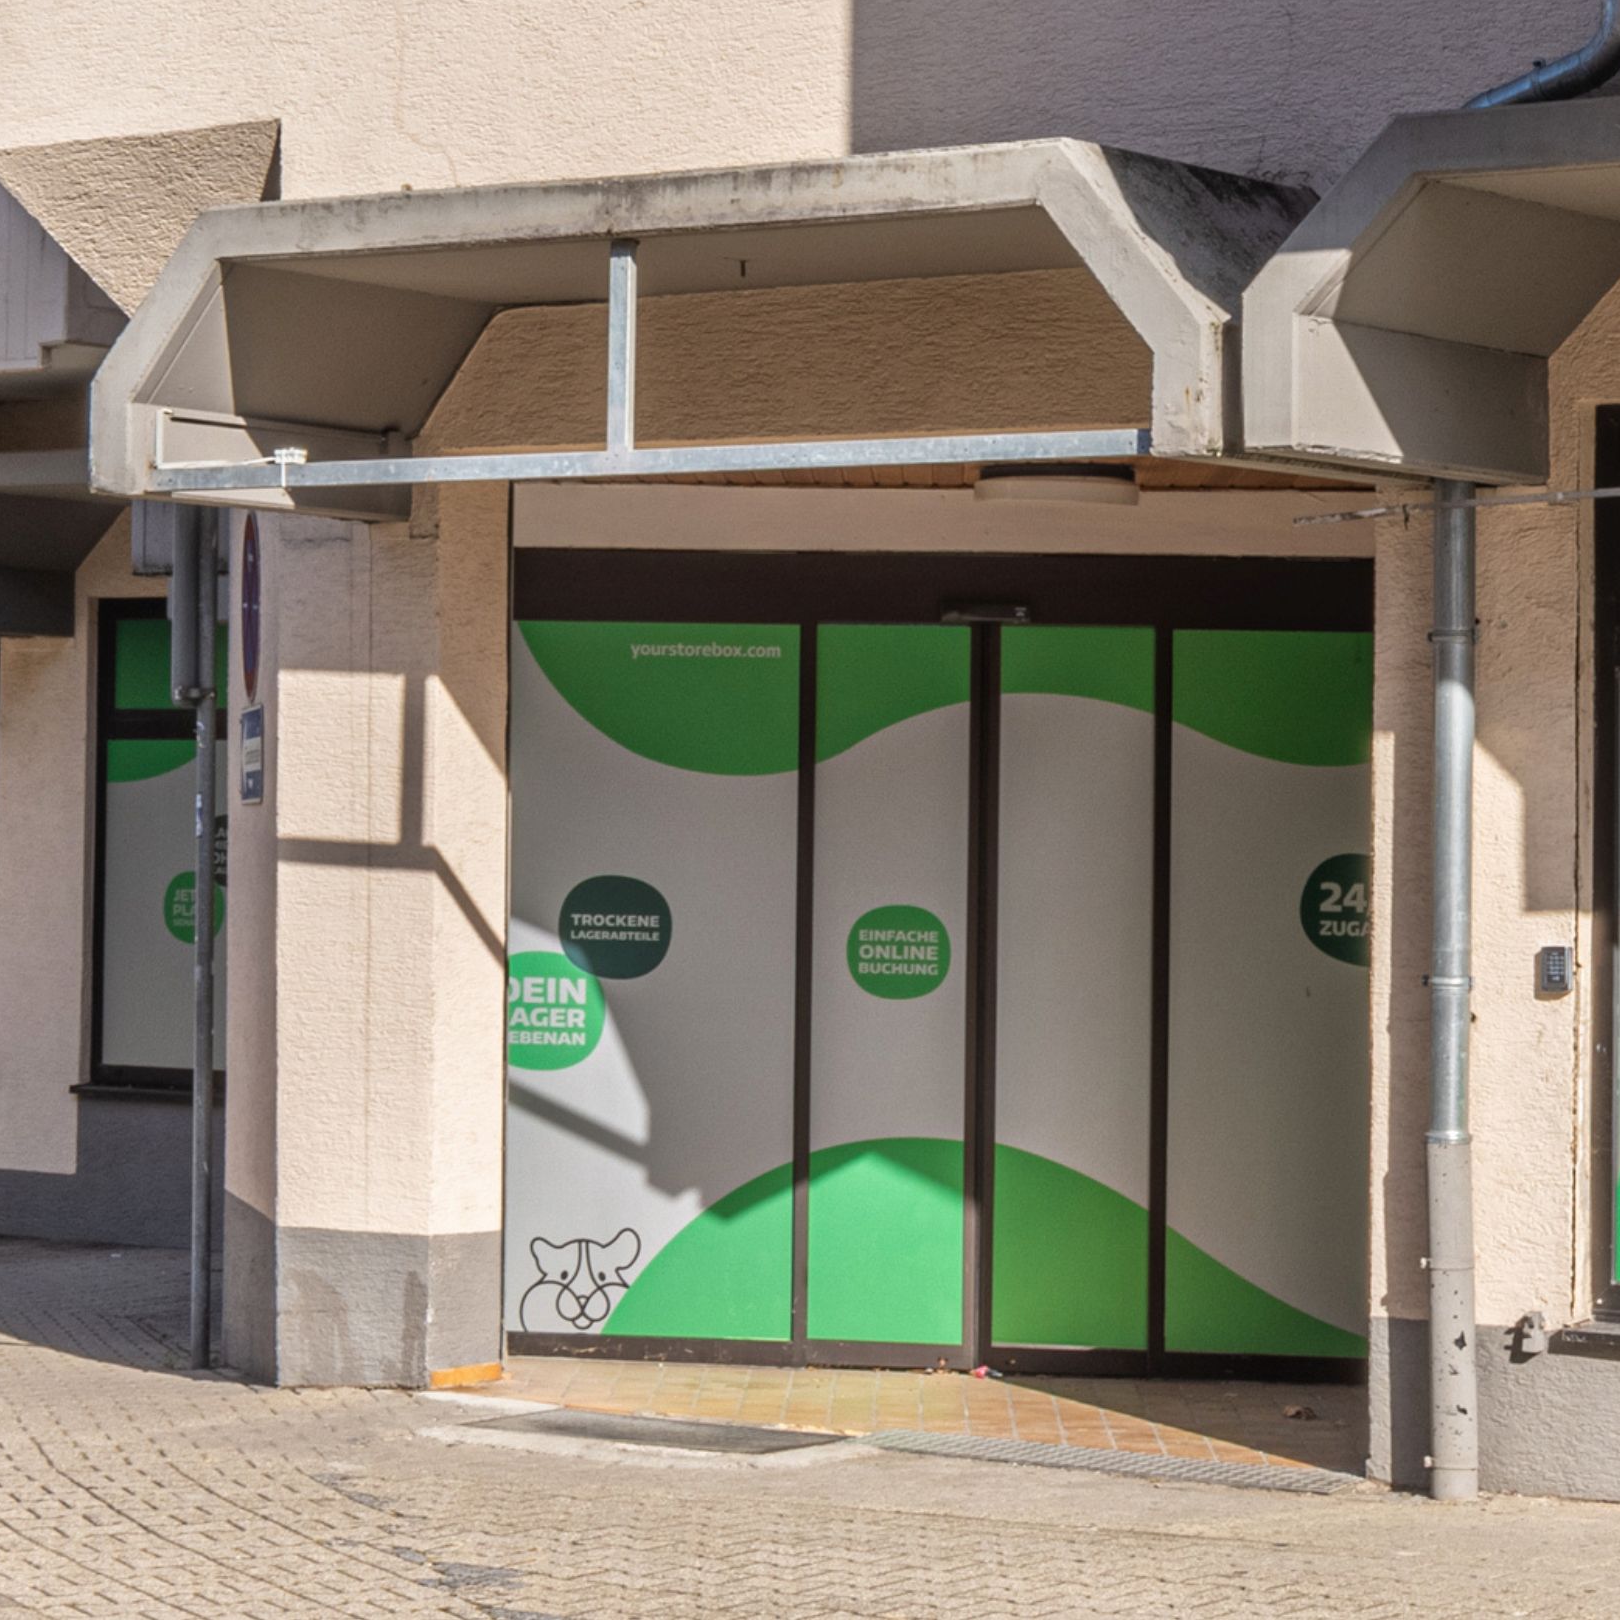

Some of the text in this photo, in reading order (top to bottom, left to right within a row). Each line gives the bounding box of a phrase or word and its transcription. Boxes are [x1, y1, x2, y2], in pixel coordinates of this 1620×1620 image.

[630, 642, 782, 659] yourstorebox.com
[570, 913, 660, 928] TROCKENE
[570, 929, 660, 942] LAGERABTEILE
[859, 929, 939, 943] EINFACHE
[859, 944, 939, 961] ONLINE
[858, 962, 939, 976] BUCHUNG
[508, 1007, 586, 1029] AGER
[508, 1030, 586, 1046] EBENAN
